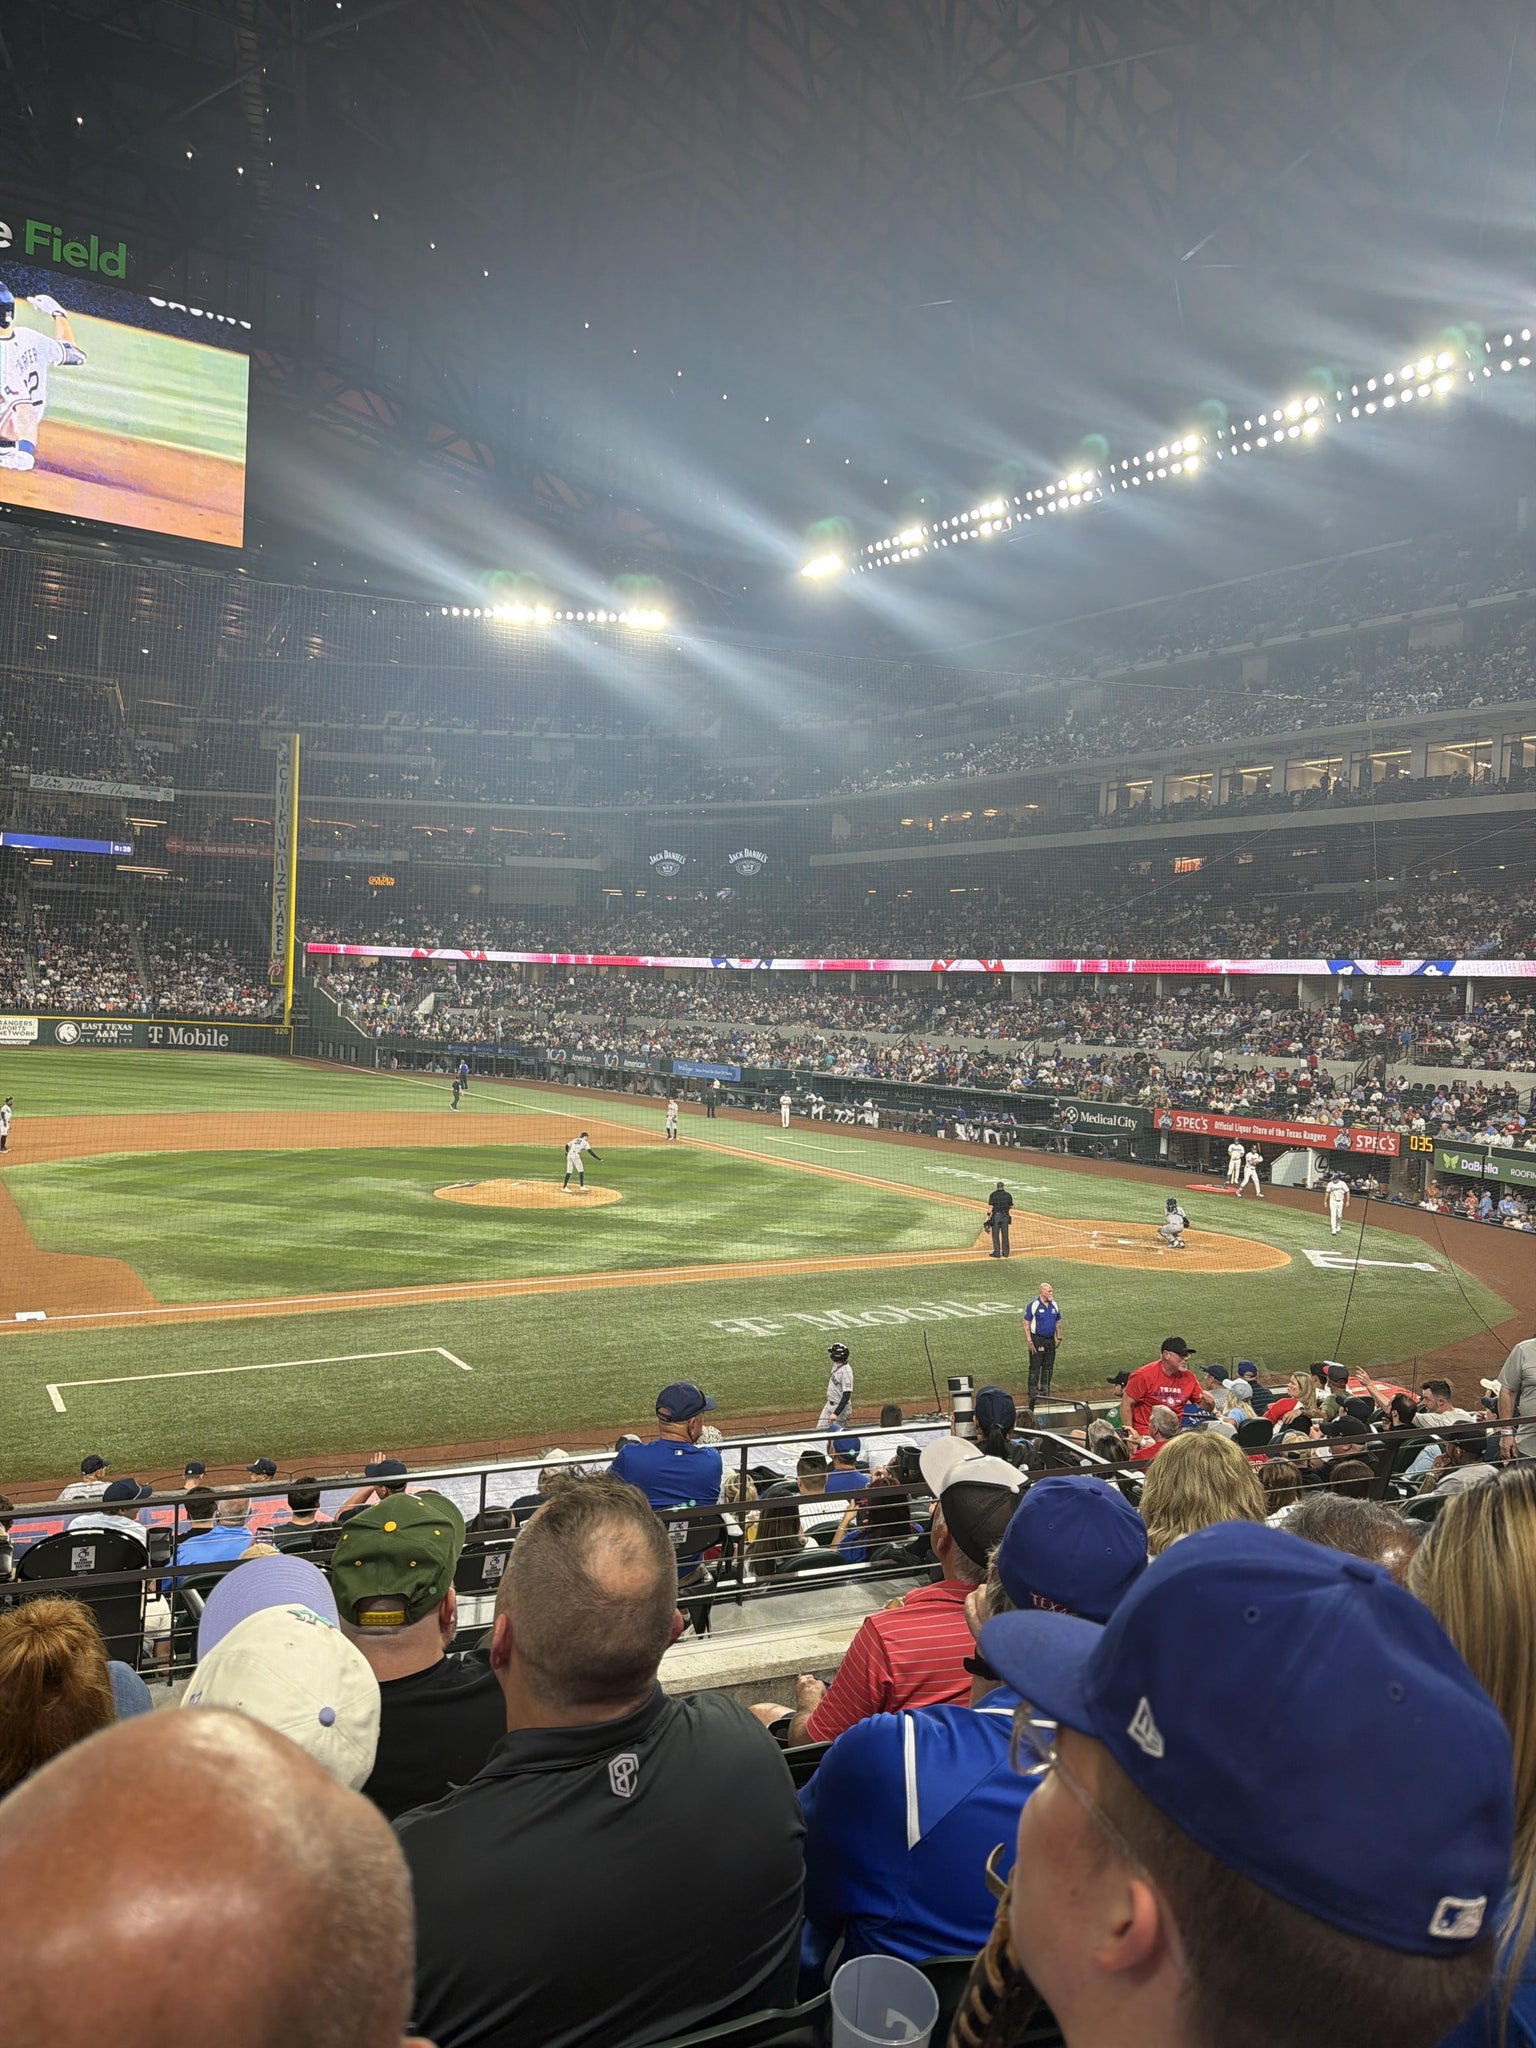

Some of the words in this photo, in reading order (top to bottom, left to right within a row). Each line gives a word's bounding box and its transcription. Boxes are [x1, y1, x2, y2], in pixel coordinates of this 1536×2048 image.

[25, 219, 126, 280] Field
[32, 776, 64, 789] Blue
[68, 779, 103, 793] Mint
[650, 853, 663, 865] JACK
[728, 852, 743, 864] JACK
[274, 894, 287, 952] FARE
[168, 1027, 229, 1047] Mobile
[571, 1054, 592, 1062] American
[624, 1060, 646, 1068] American
[1080, 1111, 1117, 1128] Medical
[1118, 1115, 1137, 1131] City
[1176, 1116, 1208, 1130] SPEC'S
[1214, 1121, 1233, 1131] Official
[1235, 1123, 1251, 1134] Liquor
[1252, 1125, 1267, 1134] Store
[1268, 1128, 1274, 1136] of
[1275, 1128, 1285, 1137] the
[1286, 1129, 1302, 1139] Texas
[1303, 1130, 1327, 1142] Rangers
[1355, 1135, 1395, 1151] SPEC'S
[1461, 1159, 1498, 1174] DaBella
[783, 1300, 1025, 1331] Mobile
[1030, 1591, 1079, 1617] TEXA
